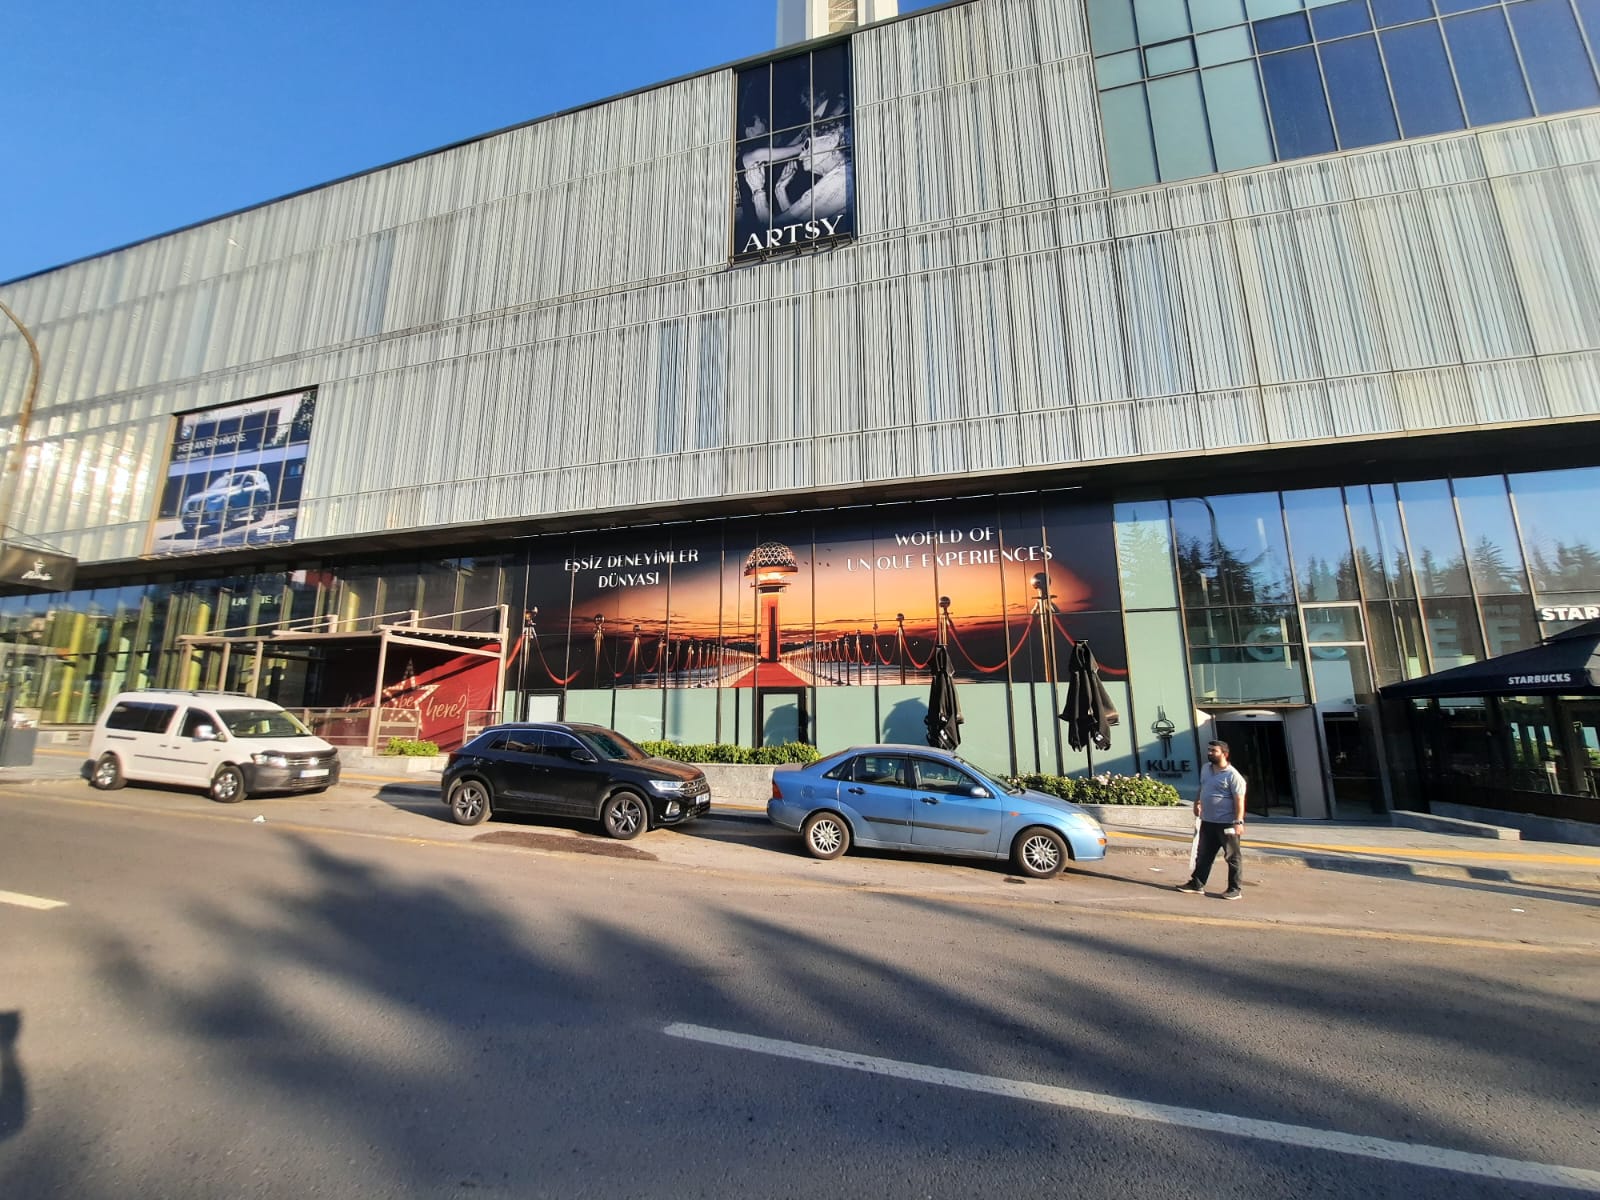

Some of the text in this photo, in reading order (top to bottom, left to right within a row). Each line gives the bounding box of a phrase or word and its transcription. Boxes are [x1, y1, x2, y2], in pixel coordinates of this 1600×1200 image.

[742, 214, 844, 253] ARTSY
[895, 526, 995, 546] WORLD OF
[607, 549, 699, 568] DENEYİMLER
[847, 545, 1053, 572] UNQUE EXPERIENCES
[598, 572, 660, 588] DÜNYASI
[1508, 674, 1571, 685] STARBUCKS
[426, 694, 467, 721] here?
[1146, 760, 1192, 772] KULE
